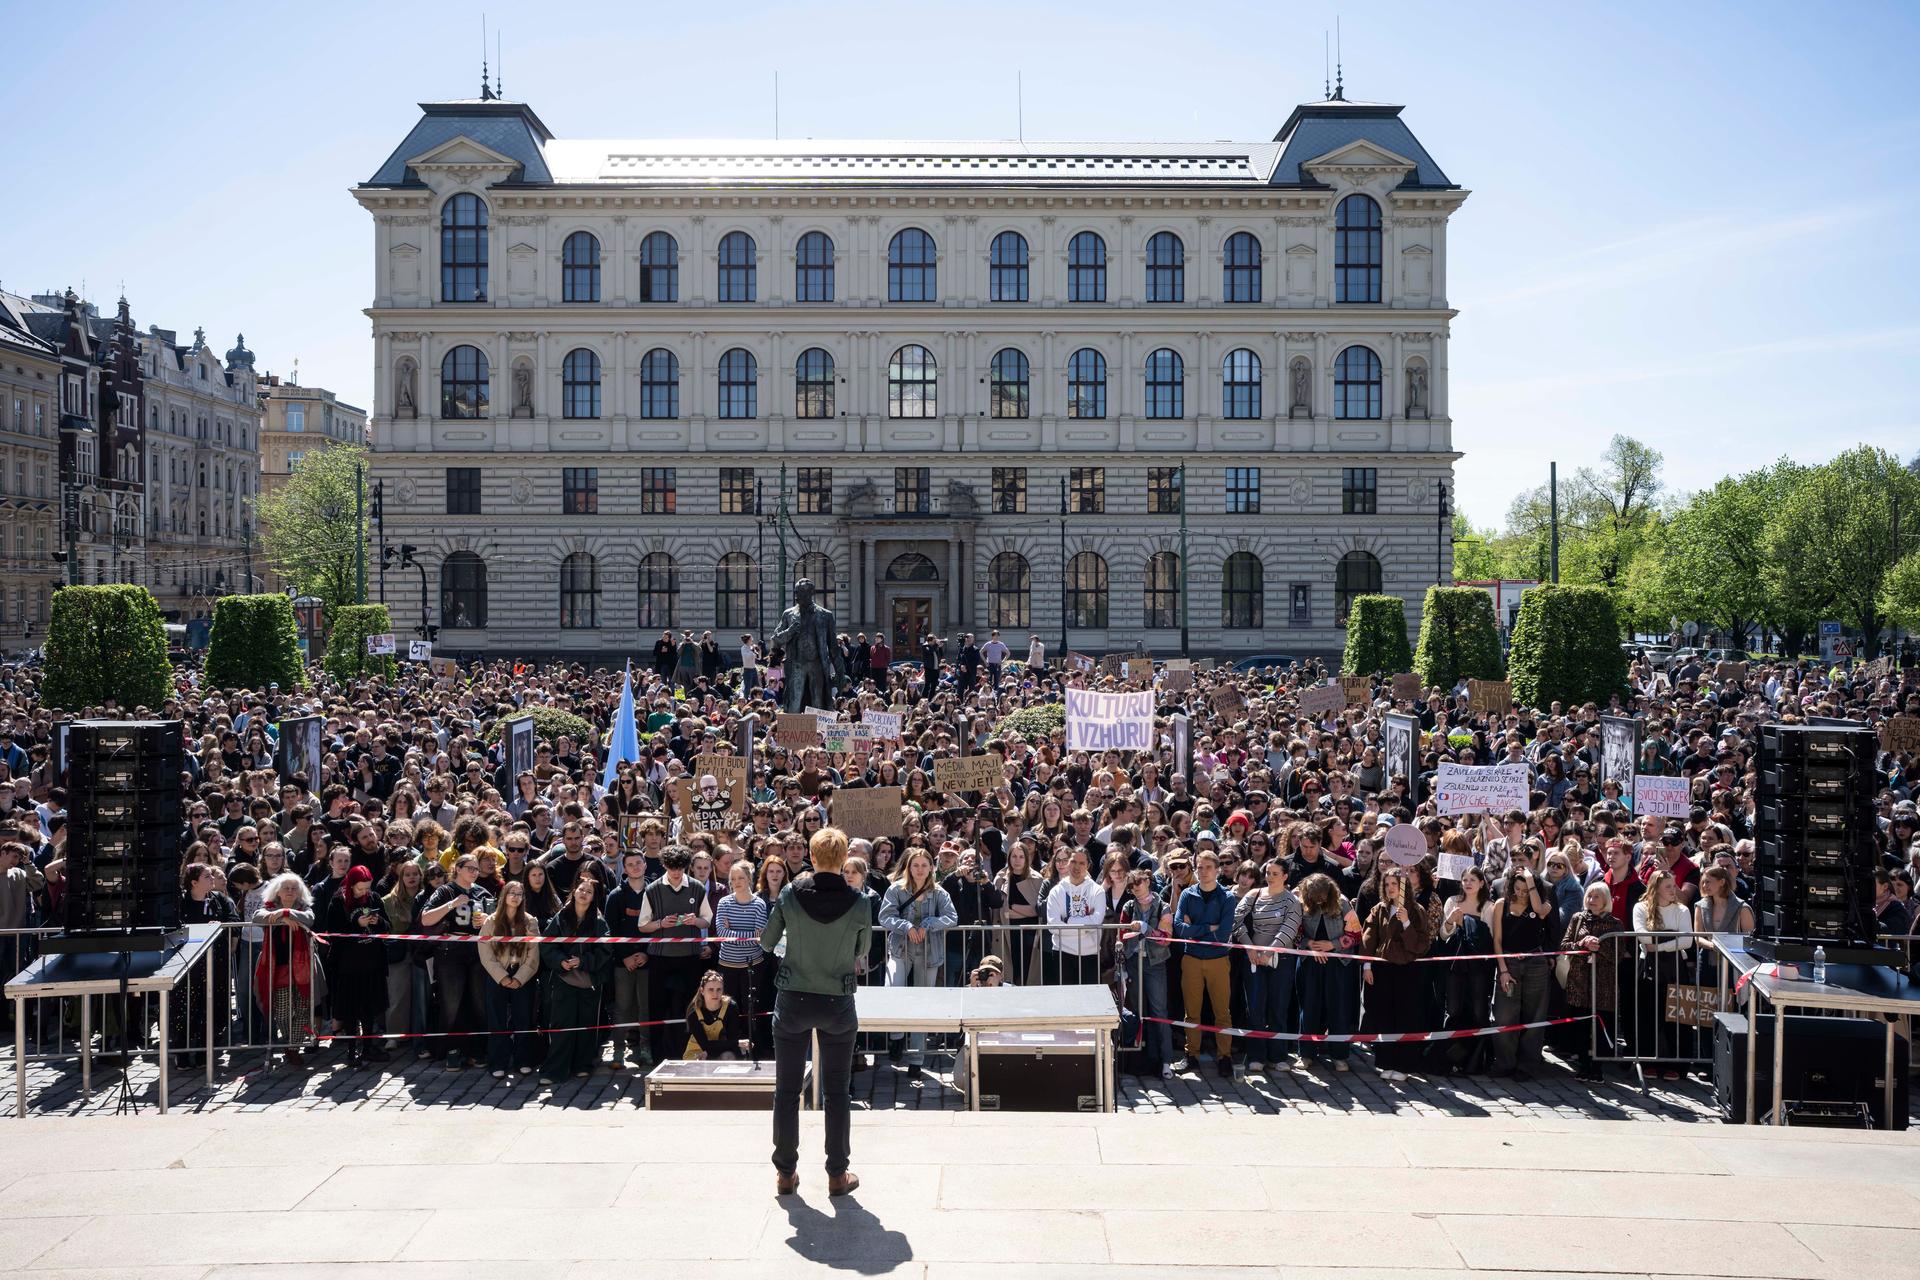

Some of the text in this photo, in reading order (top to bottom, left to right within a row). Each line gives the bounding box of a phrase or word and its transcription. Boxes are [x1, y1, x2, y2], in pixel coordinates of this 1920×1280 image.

[411, 641, 426, 656] ČT
[1068, 691, 1151, 719] KULTURU
[1078, 719, 1150, 747] VZHŮRU
[698, 756, 746, 769] PLATIT BUDU
[936, 760, 966, 773] MÉDIA
[697, 767, 710, 777] TAK
[721, 768, 734, 777] TAK
[1660, 791, 1689, 804] SVAZEK
[1637, 802, 1645, 812] A
[1650, 802, 1669, 814] JDI
[686, 808, 740, 822] MÉDIA VÁM
[1668, 1005, 1686, 1019] ZA
